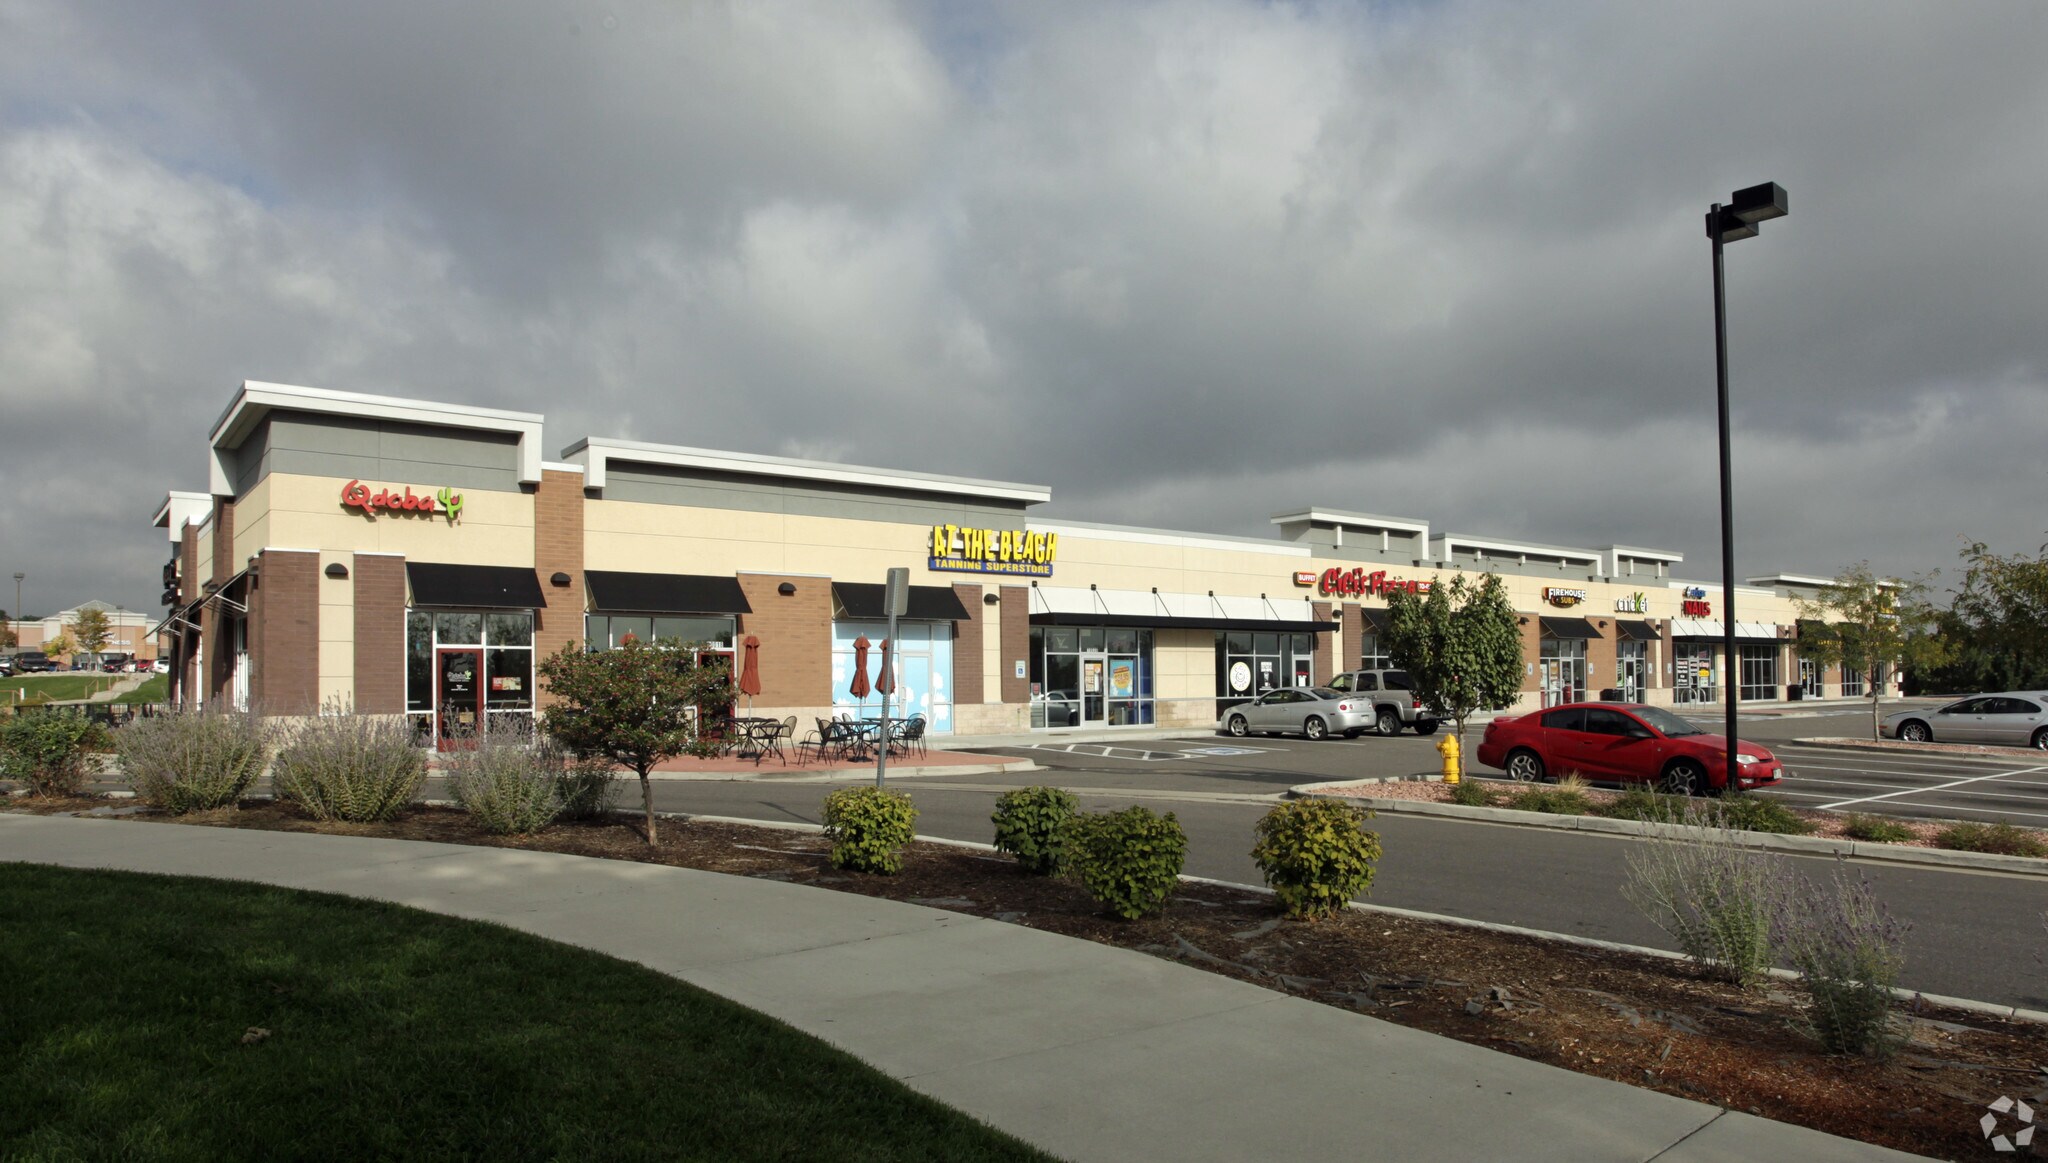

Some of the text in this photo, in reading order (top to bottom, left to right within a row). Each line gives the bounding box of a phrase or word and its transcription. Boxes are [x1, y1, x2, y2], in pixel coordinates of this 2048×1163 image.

[341, 479, 436, 513] Qdoba
[933, 524, 1058, 564] AT THE BEACH
[935, 559, 1050, 574] TANNING SUPERSTORE
[1548, 588, 1586, 600] FIREHOUSE
[1684, 601, 1711, 616] NAILS
